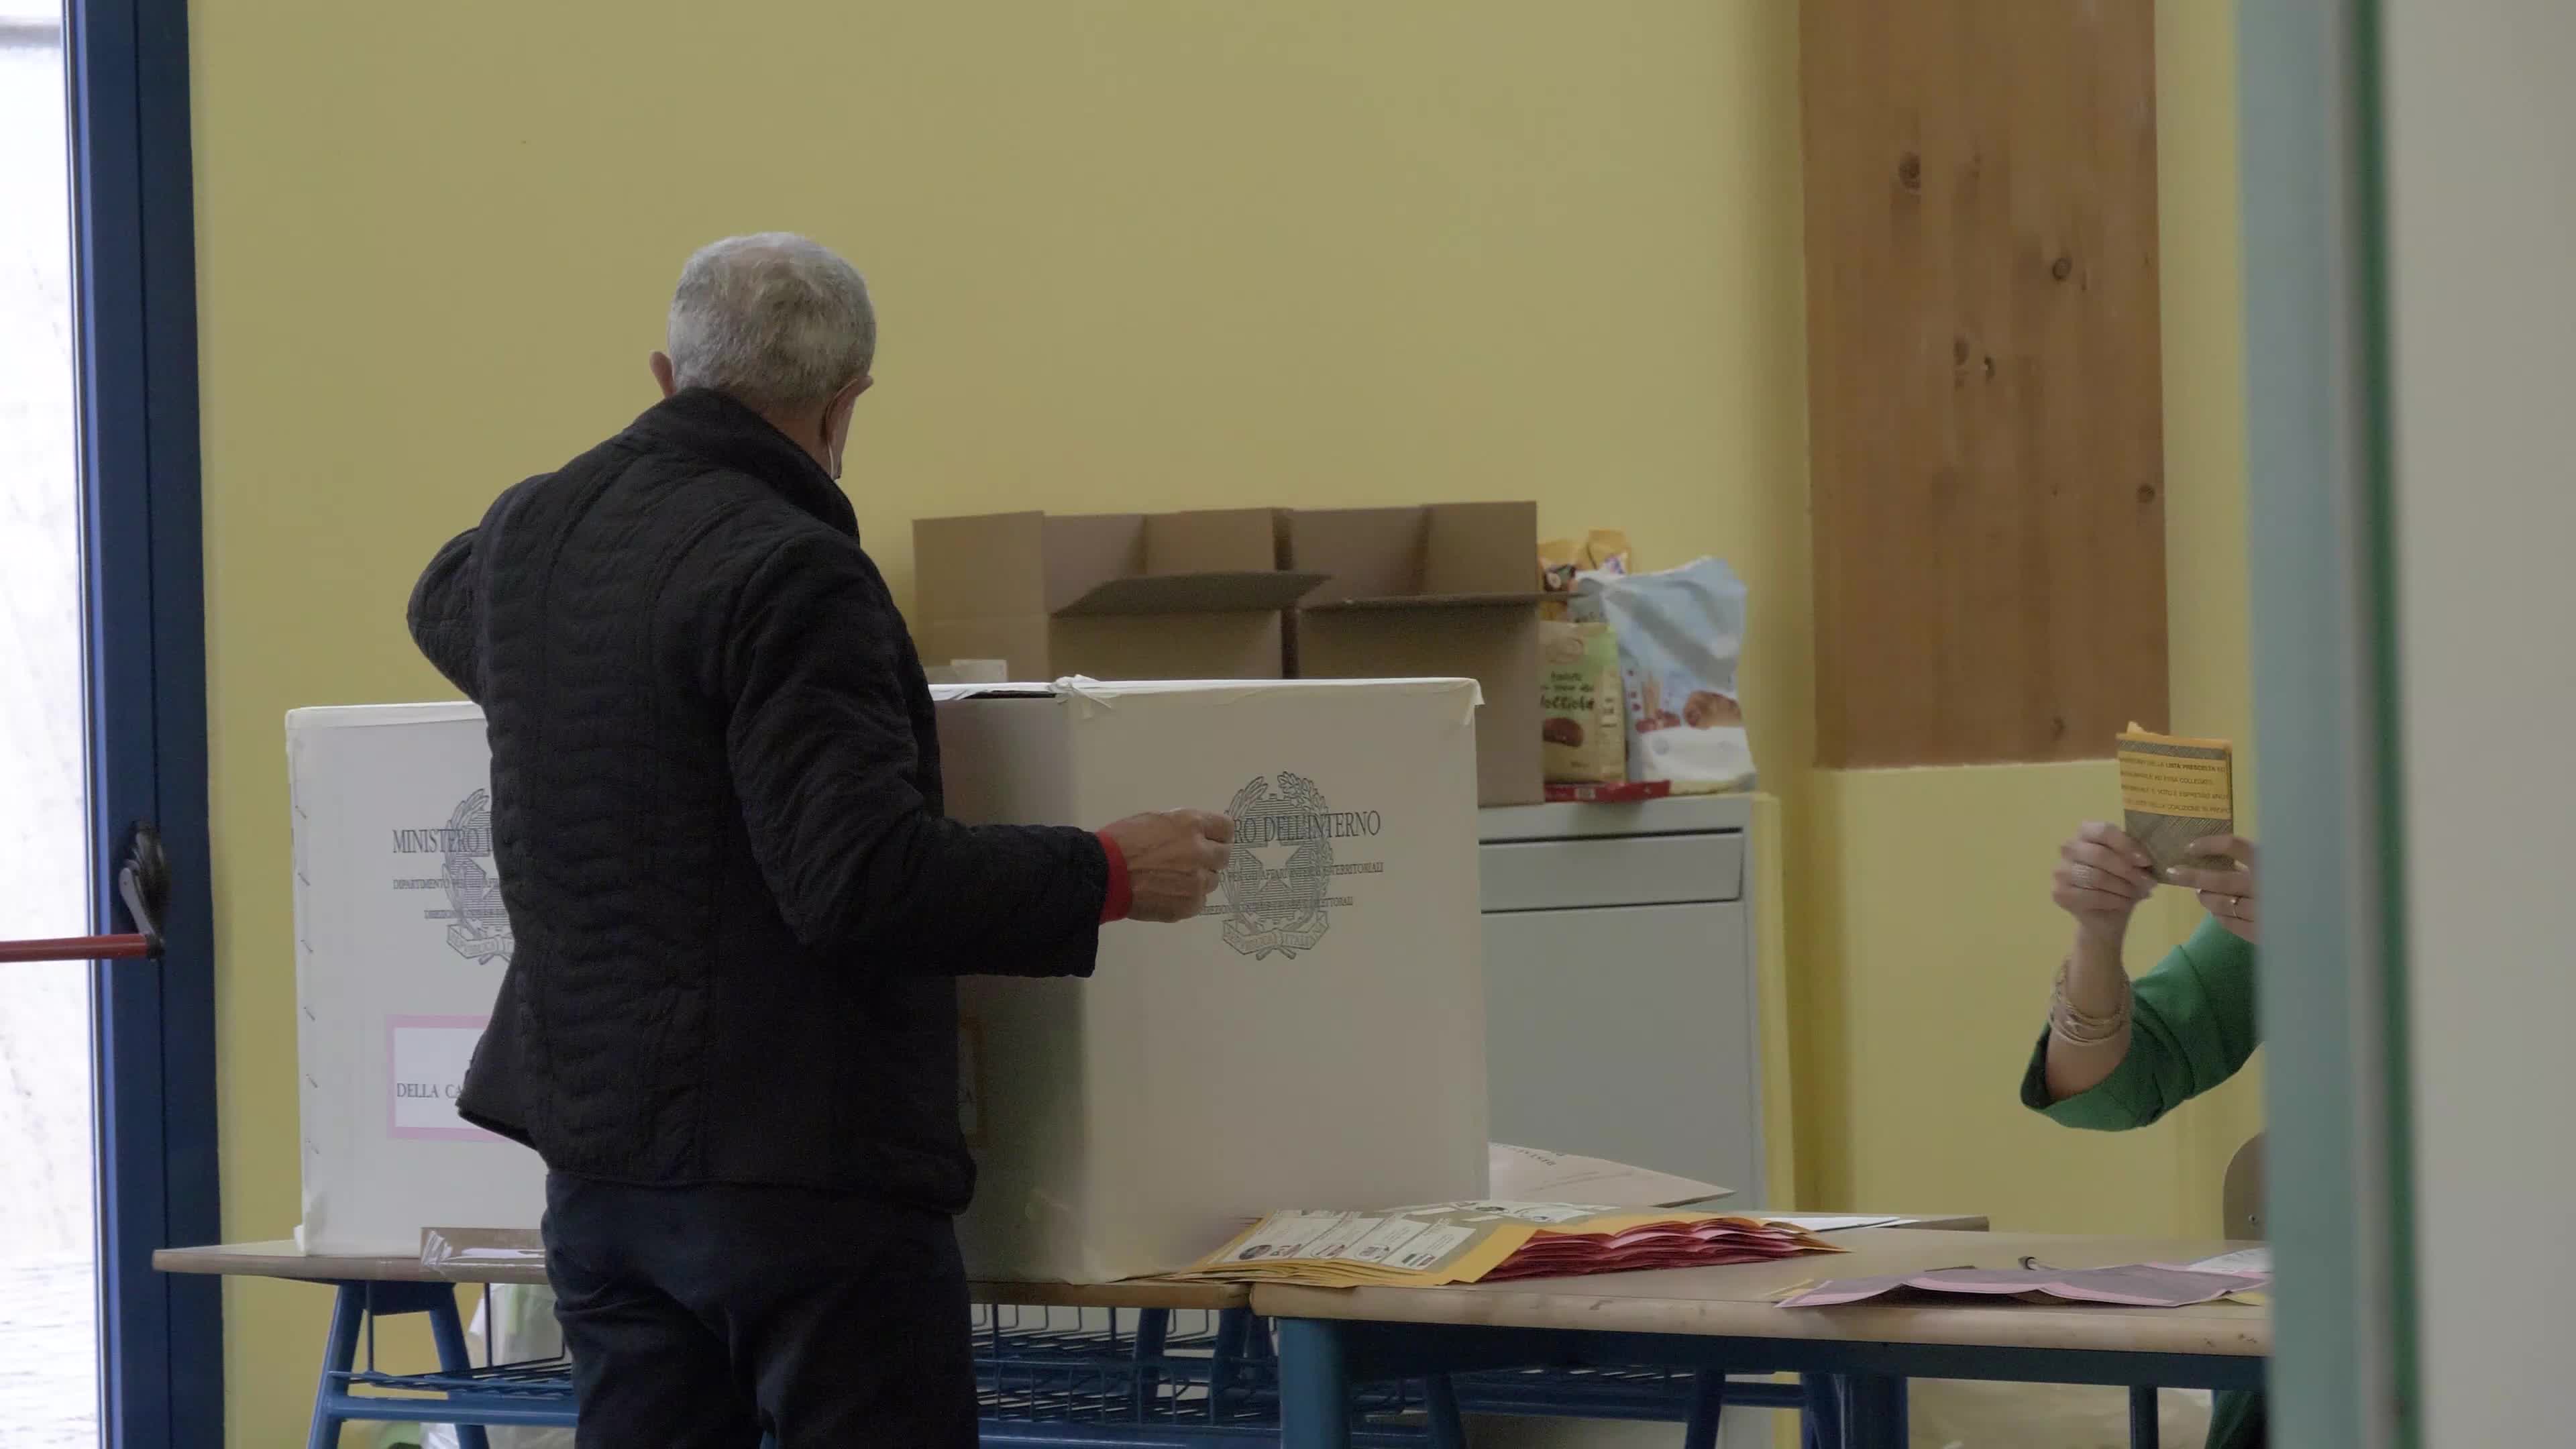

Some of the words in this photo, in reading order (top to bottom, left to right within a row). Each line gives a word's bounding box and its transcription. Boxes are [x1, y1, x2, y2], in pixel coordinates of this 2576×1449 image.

[392, 828, 479, 853] MINISTERO
[396, 1083, 439, 1098] DELLA
[445, 1083, 462, 1099] CA
